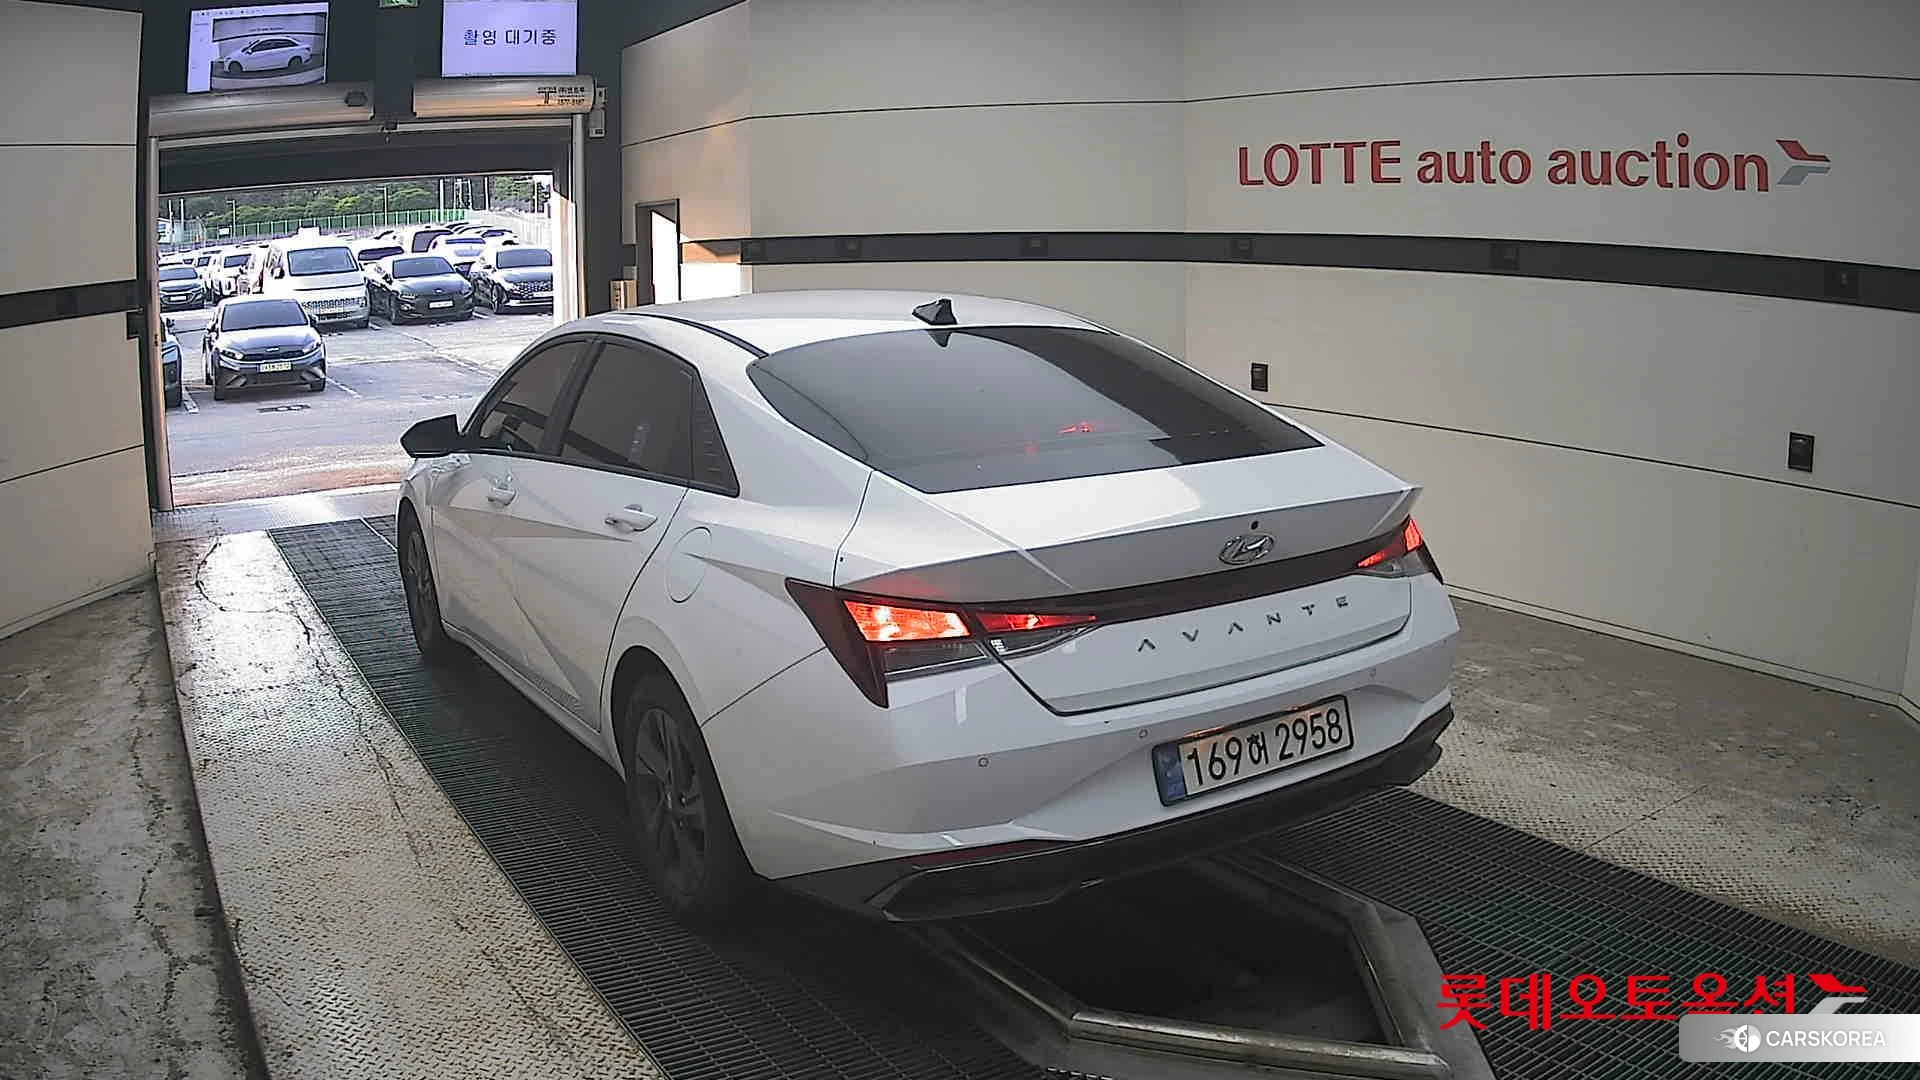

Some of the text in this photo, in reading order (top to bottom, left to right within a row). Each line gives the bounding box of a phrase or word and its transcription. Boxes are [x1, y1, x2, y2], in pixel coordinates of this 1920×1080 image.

[464, 29, 556, 46] 촬영 대기중
[1239, 133, 1769, 193] LOTTE auto auction
[1137, 595, 1350, 652] AVANTE
[1187, 731, 1269, 786] 169허
[1275, 708, 1343, 762] 2958
